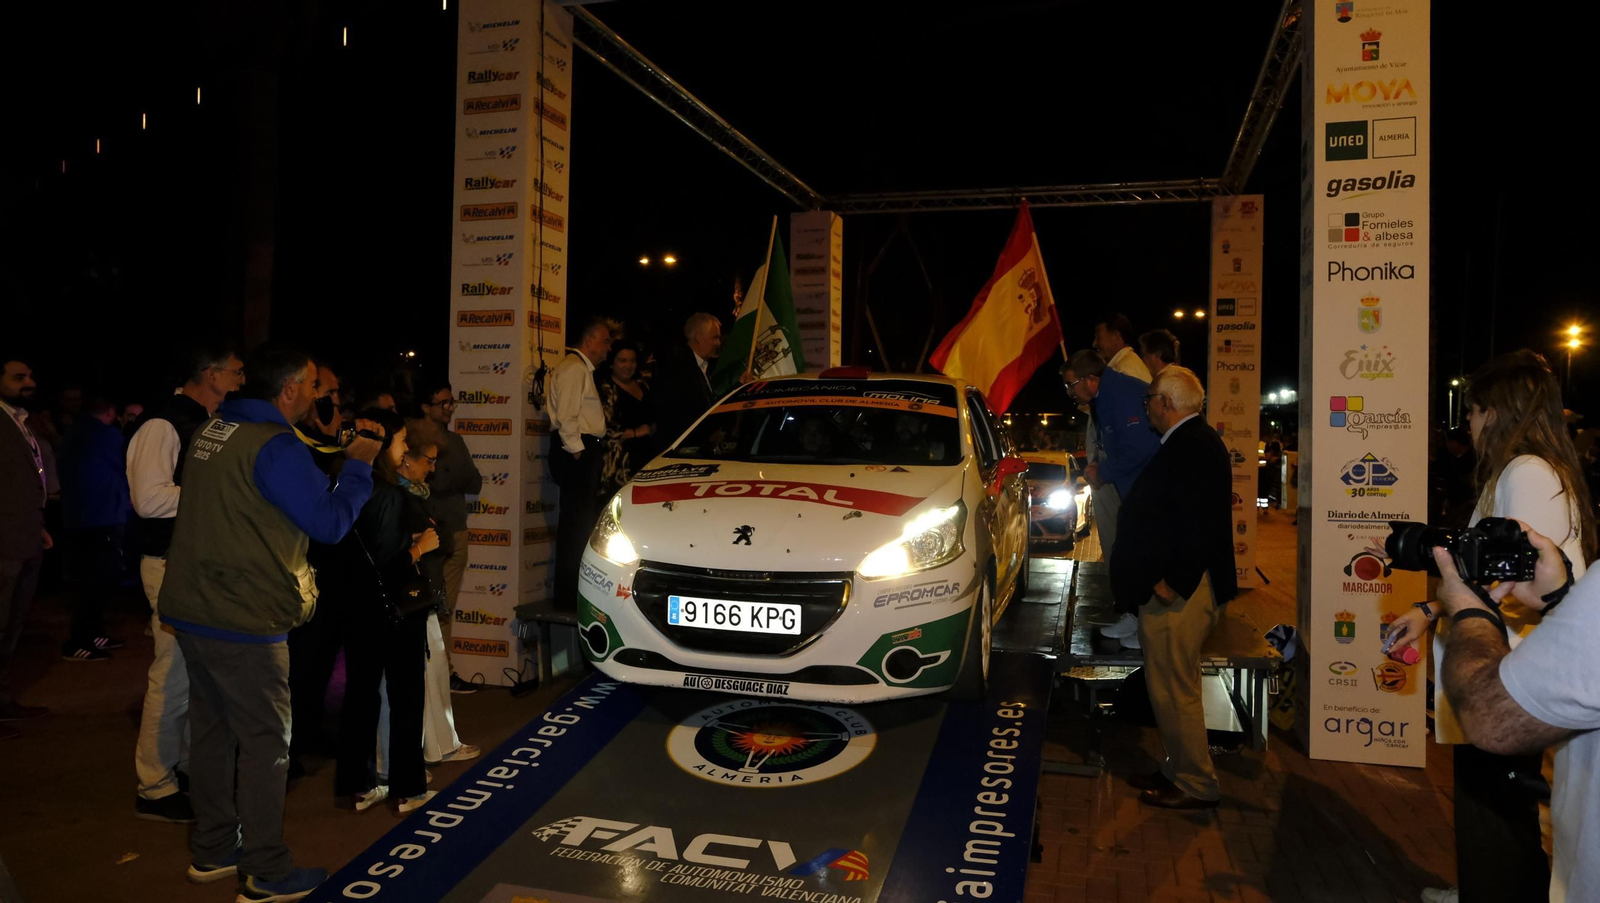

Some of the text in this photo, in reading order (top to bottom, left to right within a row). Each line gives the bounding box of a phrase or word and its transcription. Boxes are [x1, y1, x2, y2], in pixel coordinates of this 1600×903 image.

[482, 20, 520, 29] MICHELIN
[468, 70, 520, 83] Rallycar
[1326, 78, 1417, 105] MOYA
[474, 98, 509, 110] Recalvi
[478, 127, 517, 136] MICHELIN
[1329, 134, 1364, 148] UNED
[465, 177, 517, 190] Rallycar
[1326, 170, 1416, 198] gasolia
[471, 206, 507, 218] Recalvi
[1362, 211, 1385, 219] Grupo
[1362, 219, 1414, 230] Fornieles
[476, 234, 514, 242] MICHELIN
[1362, 231, 1414, 242] & albesa
[1328, 261, 1415, 282] Phonika
[462, 283, 513, 296] Rallycar
[468, 313, 504, 324] Recalvi
[1216, 321, 1256, 333] gasolia
[1216, 360, 1255, 372] Phonika
[1339, 349, 1397, 381] Enix
[458, 391, 510, 404] Rallycar
[465, 422, 501, 433] Recalvi
[690, 481, 854, 506] TOTAL
[1351, 487, 1366, 498] 30
[466, 501, 509, 515] allycar
[1327, 510, 1410, 520] Diario de Almería
[469, 563, 508, 571] MICHELIN
[1342, 582, 1393, 594] MARCADOR
[873, 582, 960, 609] EPROMCAR
[455, 609, 507, 626] Rallycar
[685, 600, 742, 625] 9166
[751, 606, 796, 630] KPG
[462, 641, 498, 653] Recalvi
[714, 678, 765, 693] DESGUACE
[766, 683, 790, 695] DIAZ
[1328, 678, 1350, 687] CRS
[1334, 705, 1369, 713] beneficio
[835, 710, 867, 735] CLUB
[1324, 717, 1410, 747] argar
[693, 763, 804, 784] ALMERIA
[550, 846, 805, 890] FEDERACIÓN DE AUTOMOVILISMO
[660, 872, 759, 894] COMUNITAT
